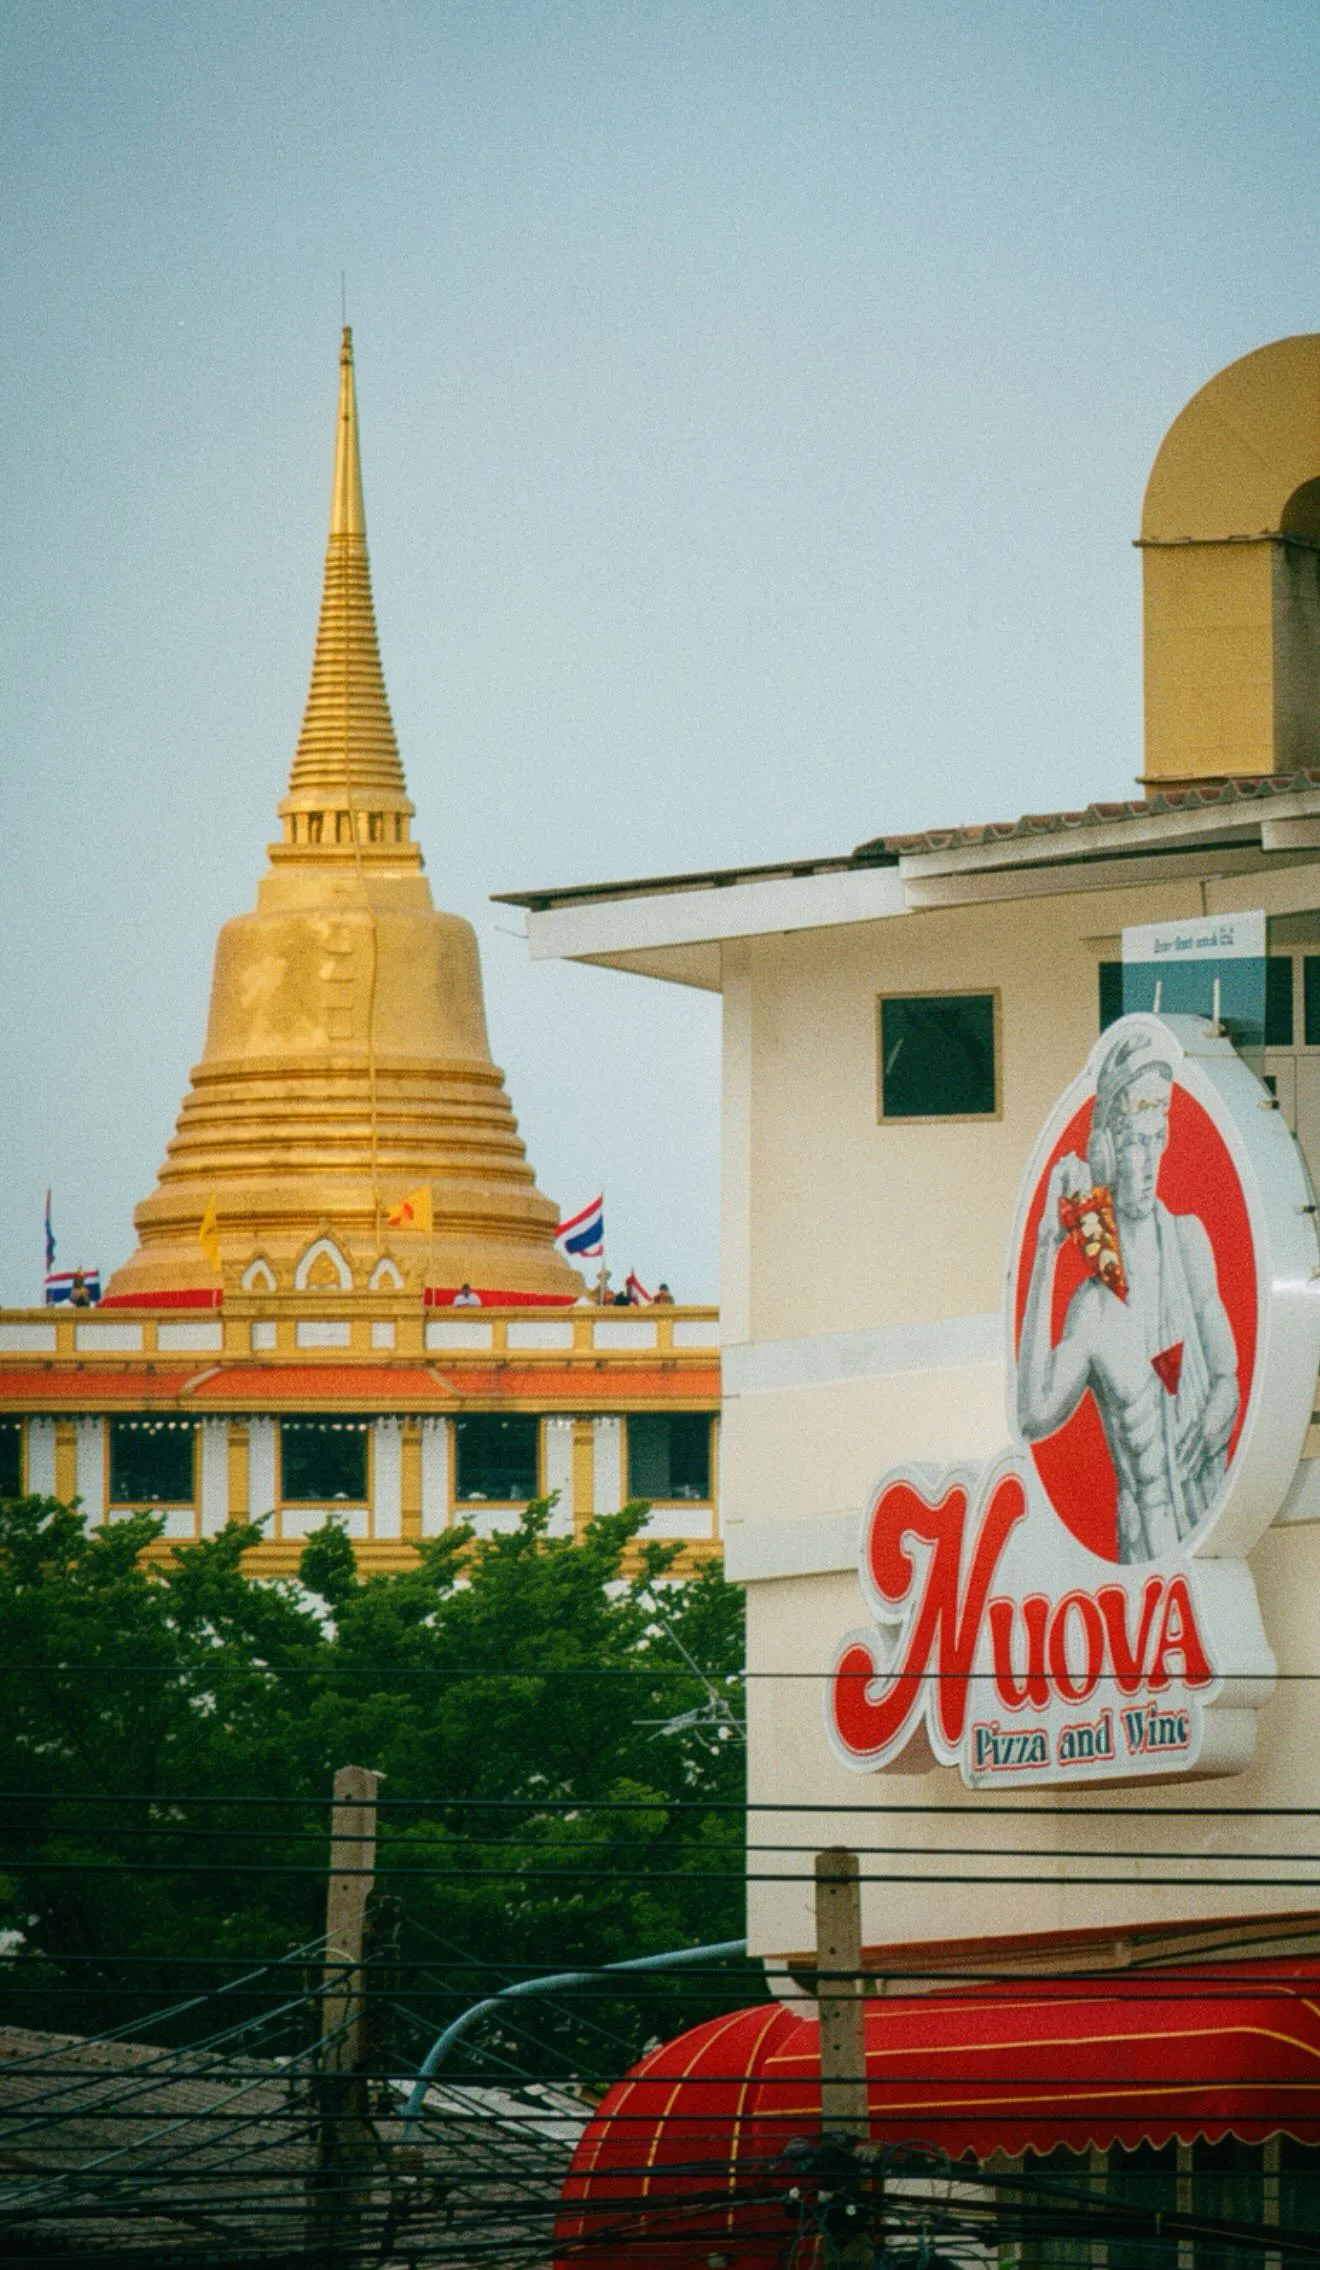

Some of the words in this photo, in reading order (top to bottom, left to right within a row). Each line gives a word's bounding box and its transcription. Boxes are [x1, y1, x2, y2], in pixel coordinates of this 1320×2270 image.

[974, 1721, 1049, 1769] Pizza
[1058, 1709, 1114, 1764] and
[1121, 1702, 1190, 1753] Wine
